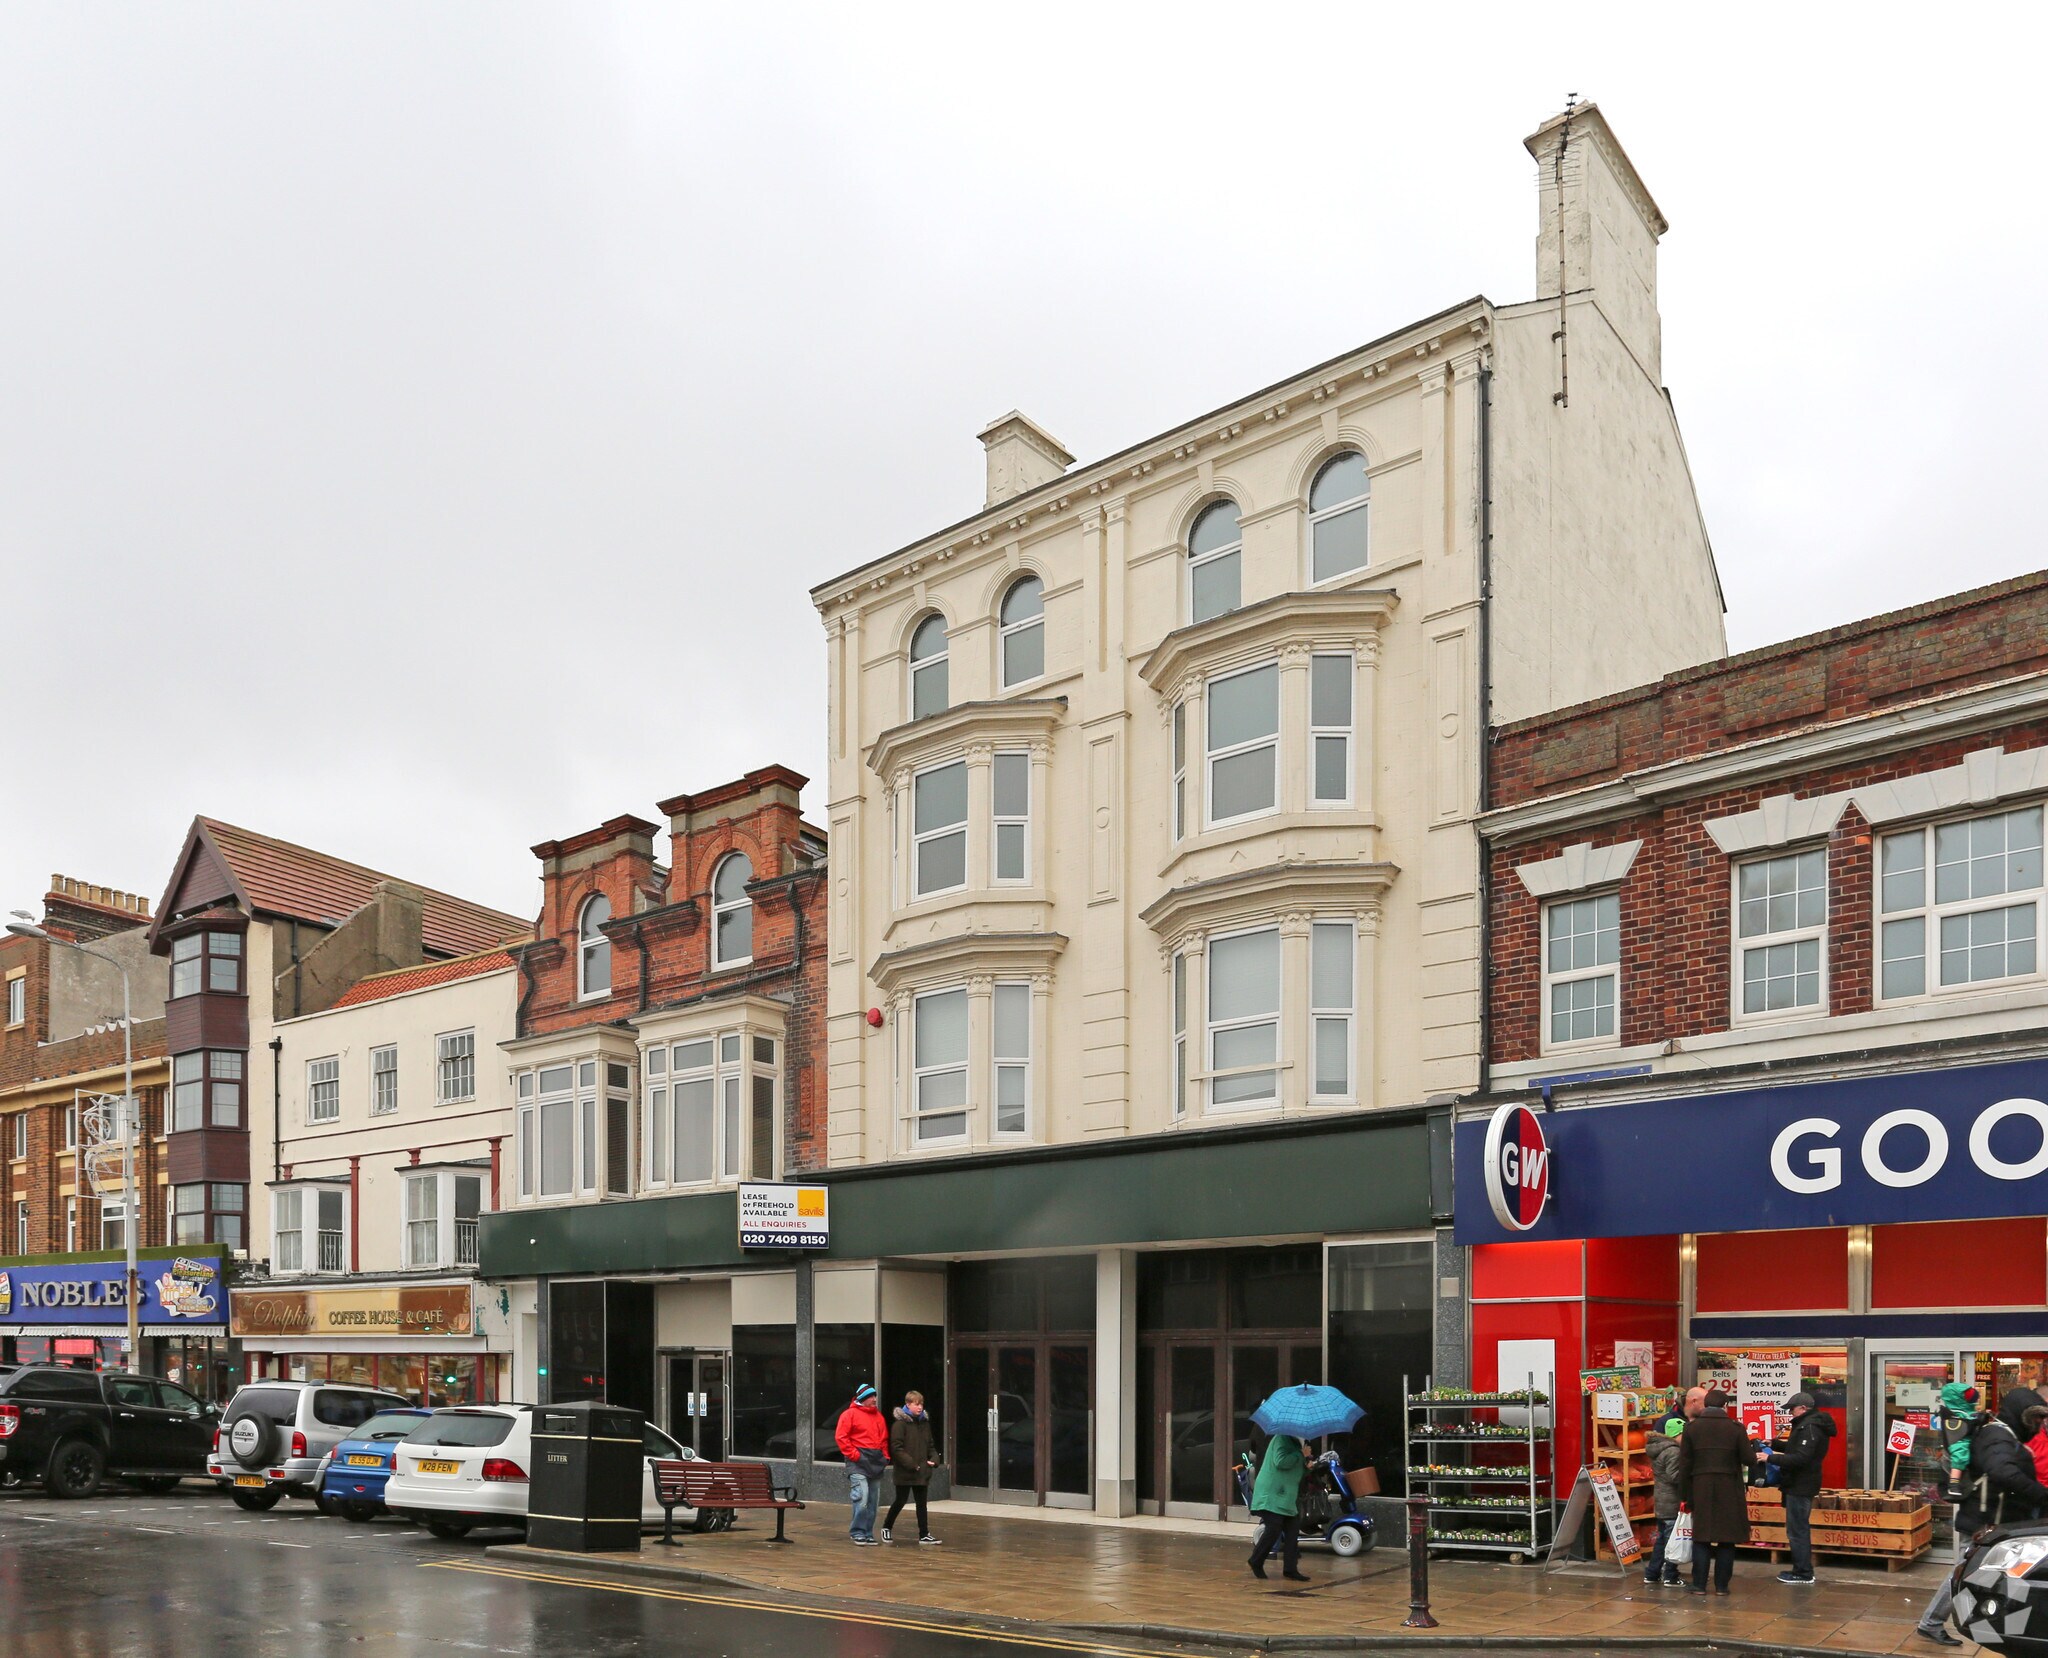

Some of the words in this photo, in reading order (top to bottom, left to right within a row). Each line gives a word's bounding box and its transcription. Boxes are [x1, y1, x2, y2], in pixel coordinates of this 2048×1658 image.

[1501, 1142, 1547, 1190] GW
[798, 1207, 824, 1216] savills
[743, 1220, 759, 1228] ALL
[742, 1234, 766, 1244] 020
[768, 1234, 797, 1244] 7409
[799, 1235, 826, 1245] 8150
[252, 1299, 316, 1335] Dolphin
[329, 1310, 368, 1325] COFFEE
[368, 1309, 404, 1325] HOUSE
[405, 1310, 415, 1324] &
[416, 1306, 445, 1324] CAFÉ
[1746, 1414, 1772, 1440] £1
[1891, 1435, 1911, 1447] £7.99
[547, 1454, 568, 1463] LITTER
[422, 1462, 437, 1471] M28
[437, 1463, 453, 1472] FEN
[1748, 1489, 1760, 1498] YS
[1748, 1508, 1760, 1519] YS
[1823, 1512, 1848, 1524] STAR
[1851, 1513, 1878, 1525] BUYS
[1676, 1528, 1693, 1537] TES
[1824, 1532, 1849, 1544] STAR
[1853, 1534, 1879, 1546] BUYS
